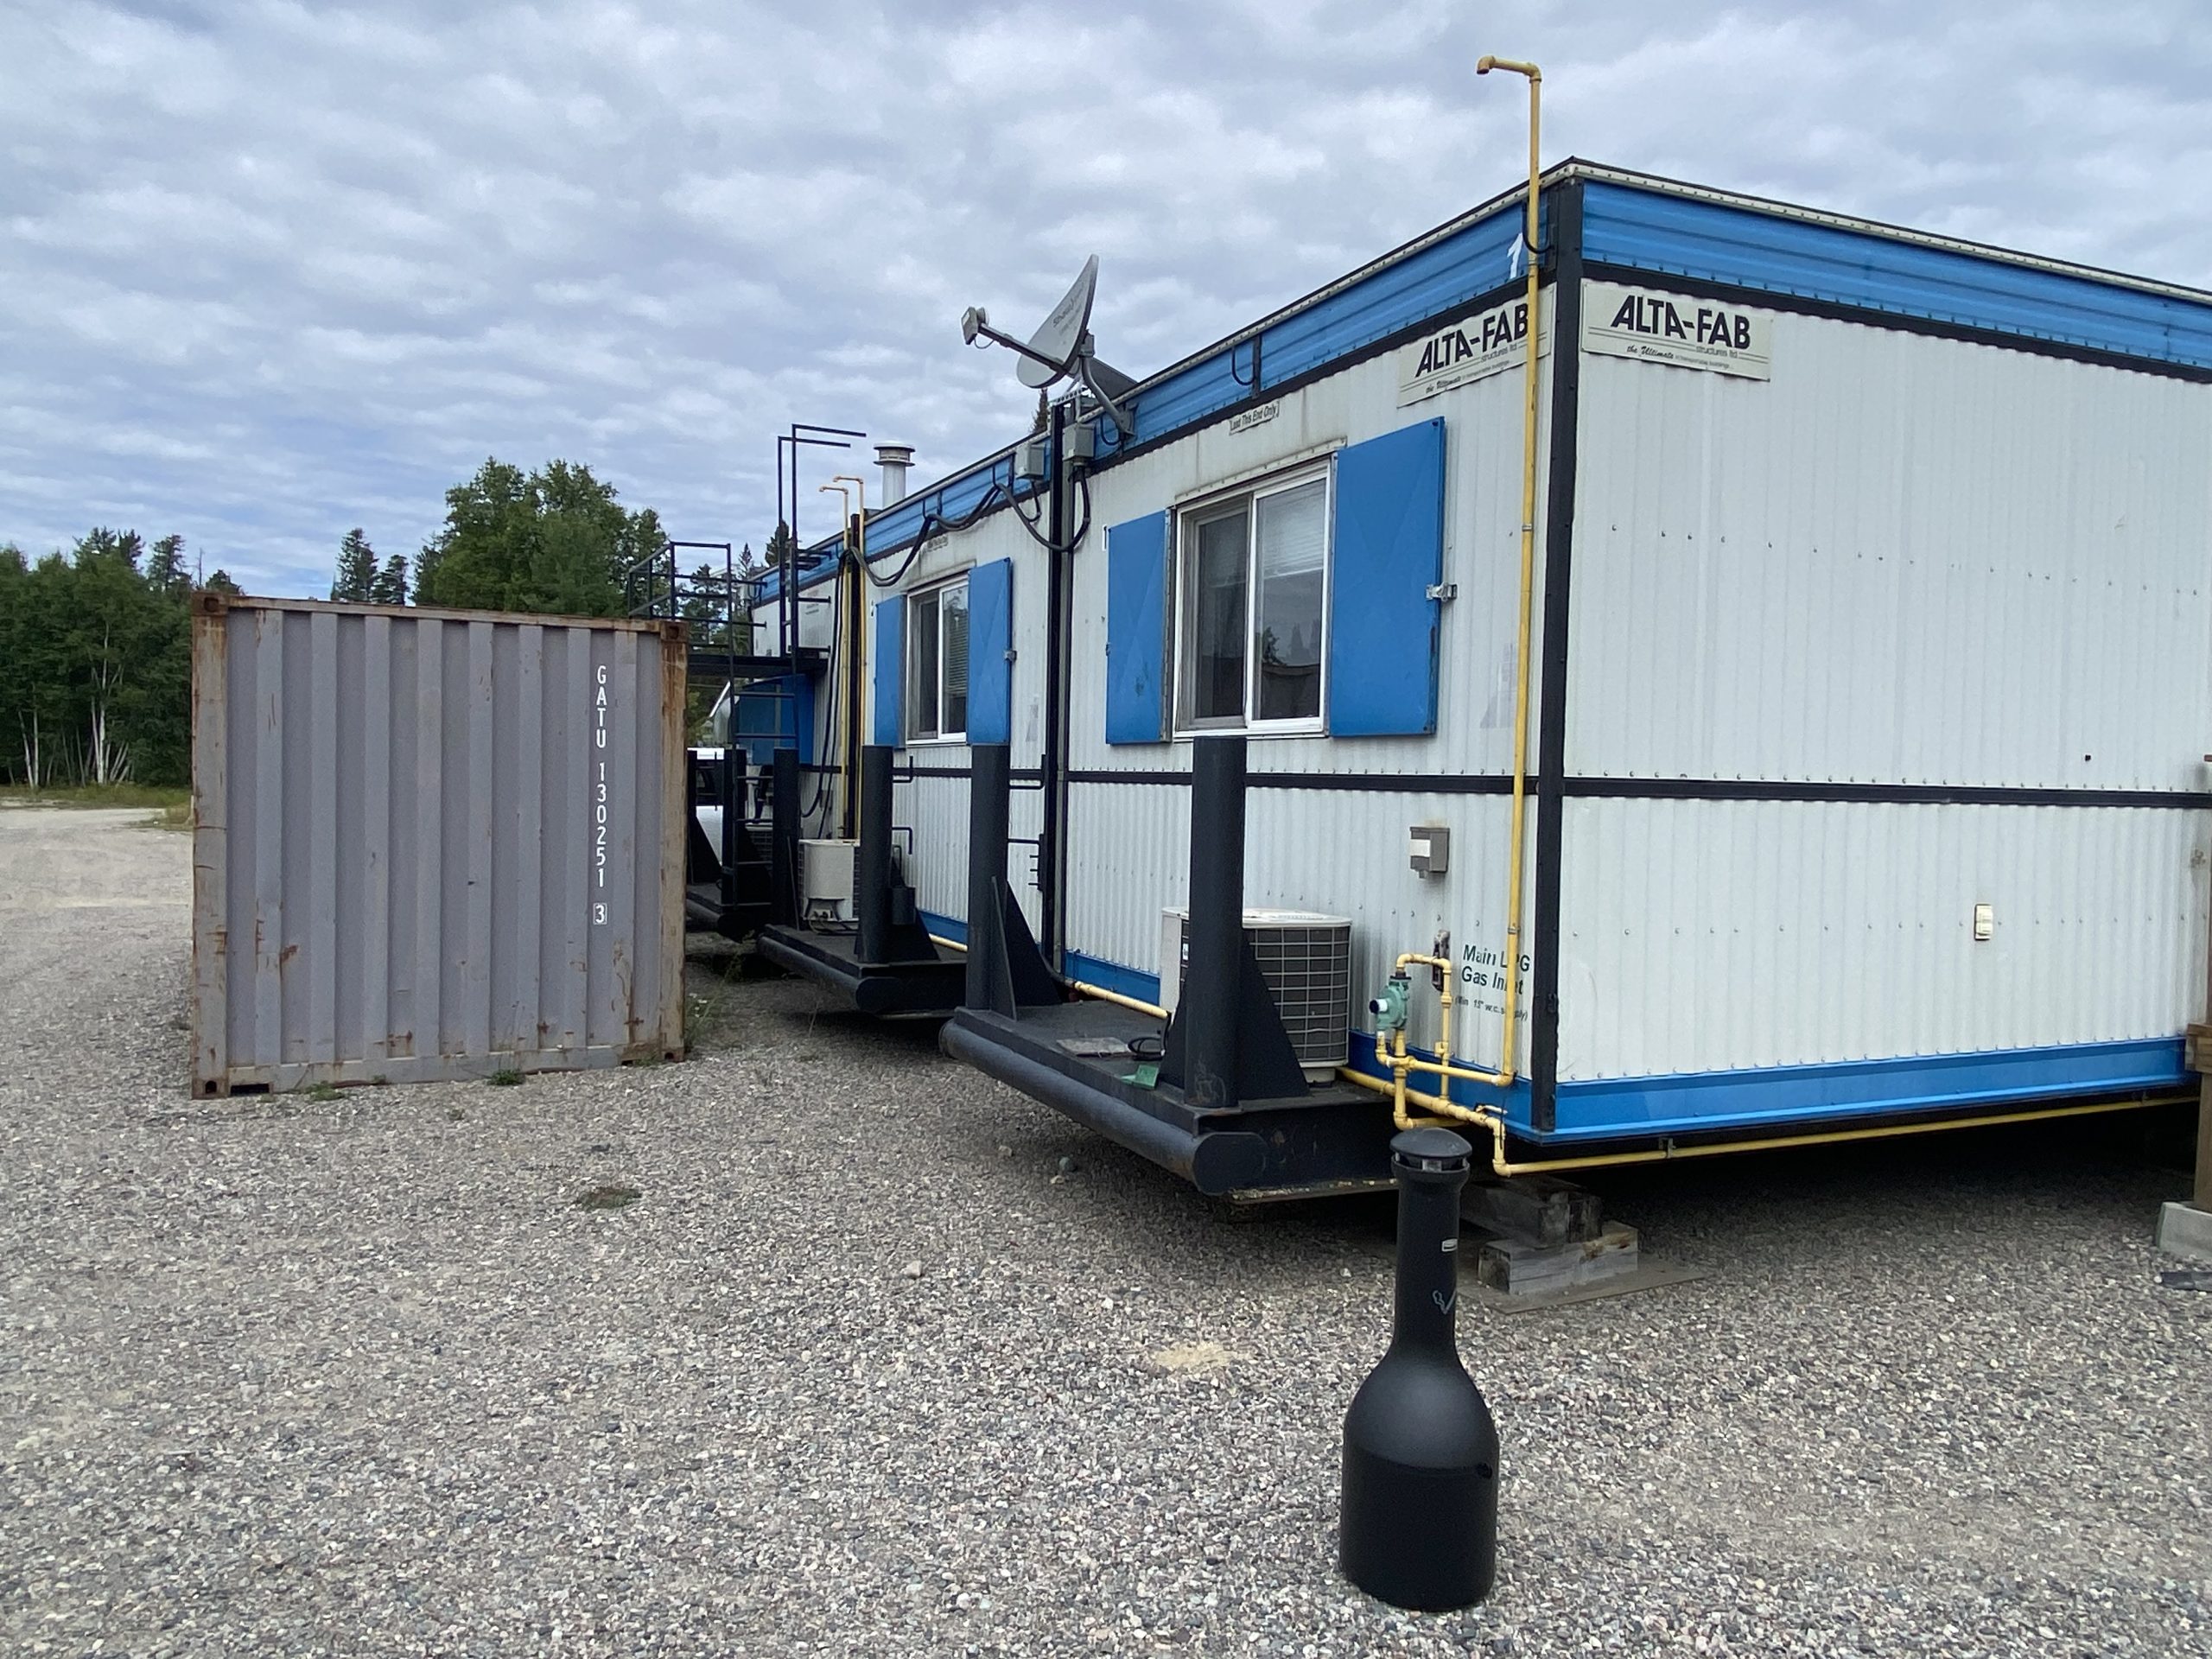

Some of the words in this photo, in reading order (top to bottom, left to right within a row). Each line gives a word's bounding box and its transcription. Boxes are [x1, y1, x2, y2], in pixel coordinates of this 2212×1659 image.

[1507, 232, 1523, 280] 1
[1415, 302, 1529, 378] ALTA-FAB
[1611, 295, 1751, 350] ALTA-FAB
[1627, 346, 1637, 354] the
[596, 665, 607, 748] GATU
[595, 762, 607, 887] 130251
[594, 905, 606, 924] 3
[1461, 965, 1488, 986] Gas
[1463, 944, 1497, 966] Main
[1500, 950, 1530, 972] LG
